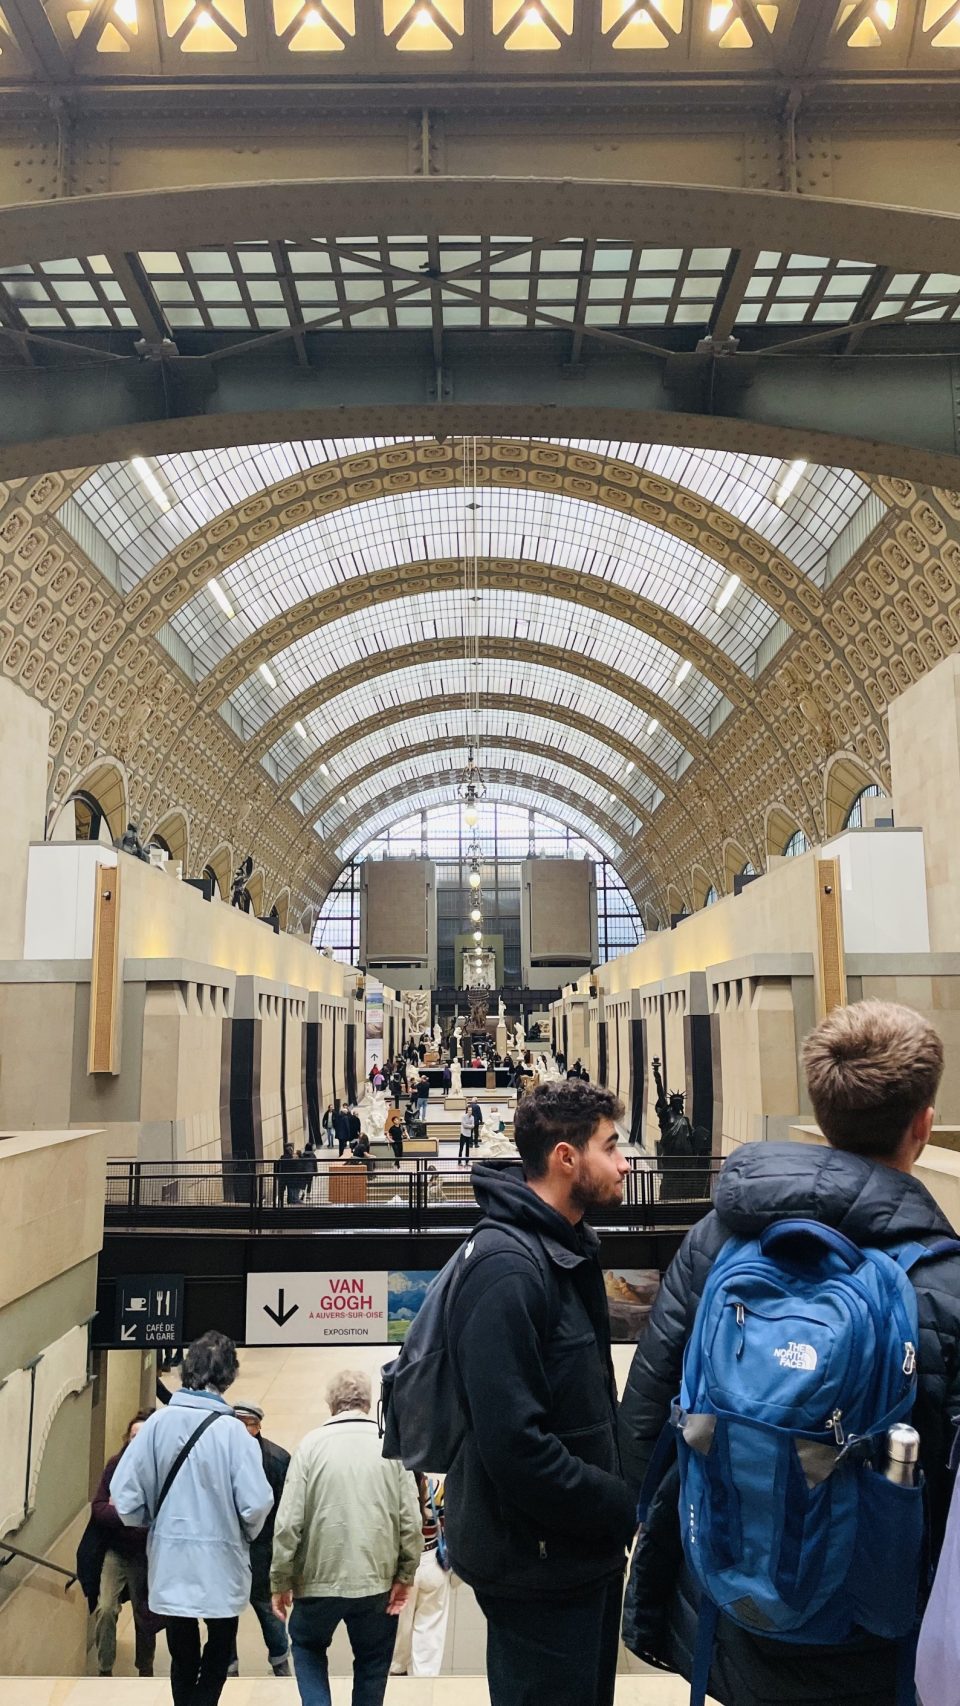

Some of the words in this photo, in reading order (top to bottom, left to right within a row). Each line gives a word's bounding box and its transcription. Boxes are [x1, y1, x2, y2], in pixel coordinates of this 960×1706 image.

[329, 1279, 364, 1293] VAN
[320, 1295, 373, 1310] GOGH
[316, 1311, 384, 1319] AUVERS-SUR-OISE
[146, 1322, 164, 1332] CAFÉ
[165, 1323, 175, 1332] DE
[323, 1328, 369, 1336] EXPOSITION
[145, 1332, 154, 1341] LA
[156, 1332, 175, 1341] GARE
[787, 1341, 806, 1351] THE
[773, 1348, 804, 1360] NORTH
[779, 1358, 804, 1369] FACE
